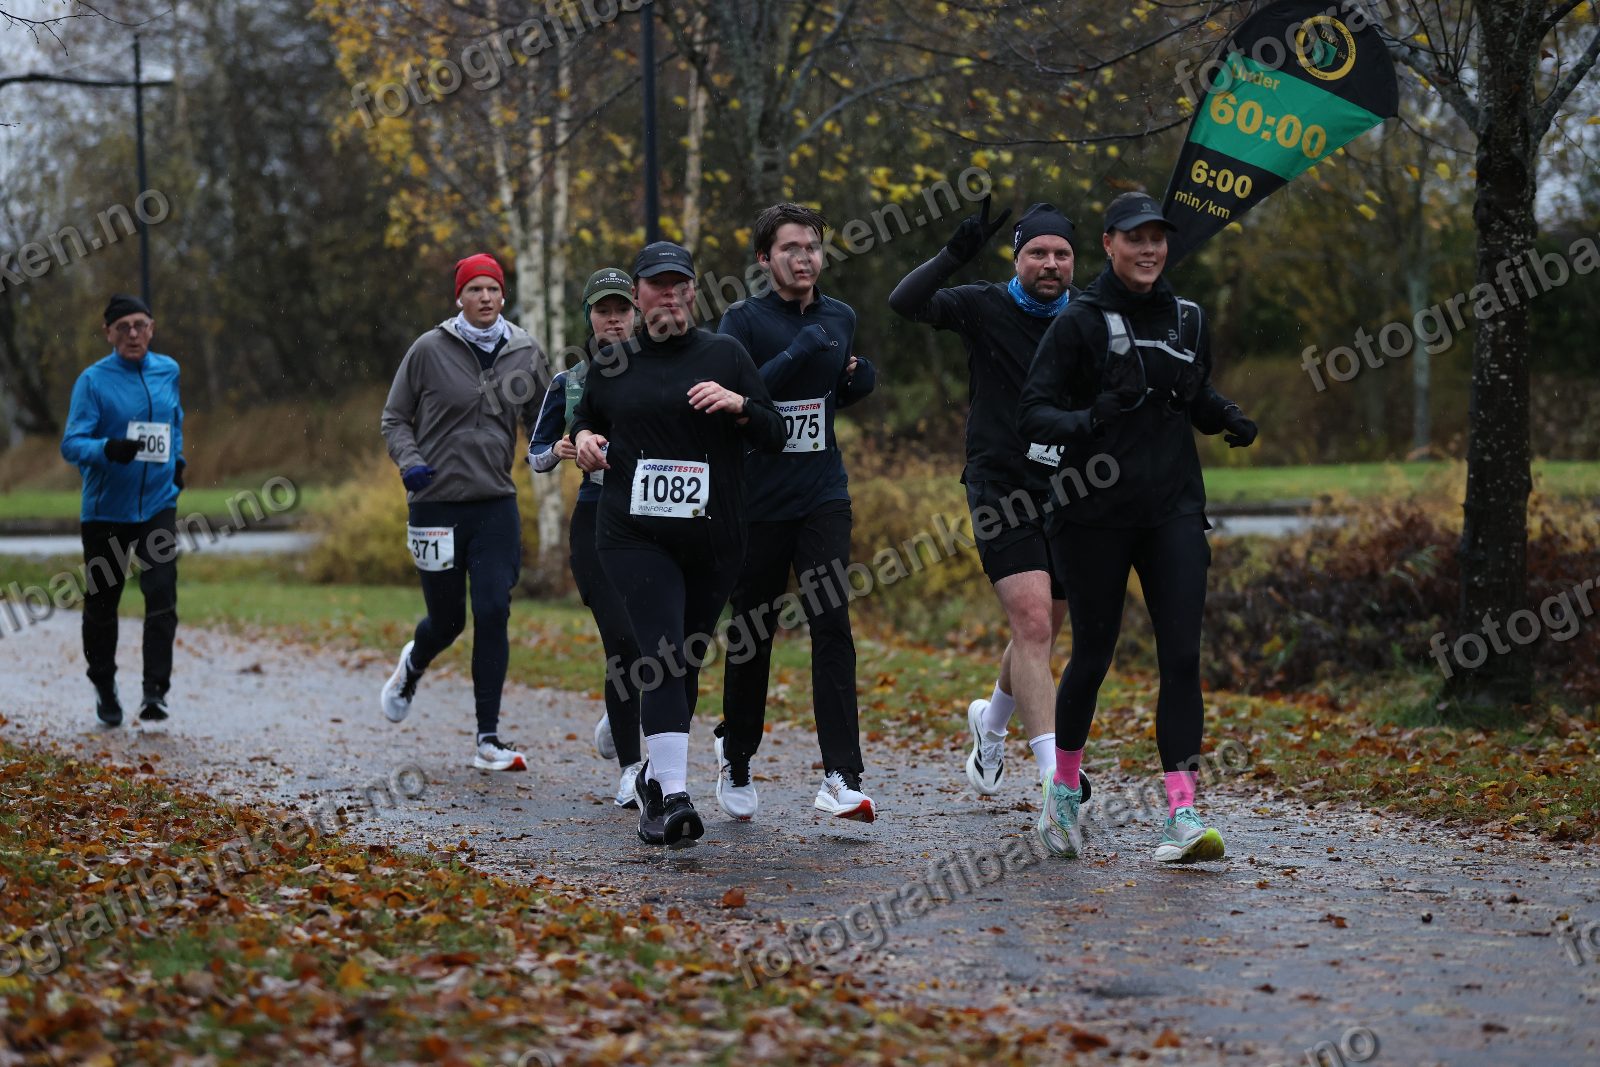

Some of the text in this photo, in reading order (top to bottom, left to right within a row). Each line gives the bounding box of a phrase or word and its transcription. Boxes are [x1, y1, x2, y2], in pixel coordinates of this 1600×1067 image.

[1232, 63, 1281, 91] Under
[1210, 91, 1327, 159] 60:00
[1191, 159, 1253, 199] 6:00
[1174, 189, 1231, 220] min/km
[137, 434, 166, 454] 506
[640, 474, 702, 504] 1082
[412, 539, 439, 560] 371
